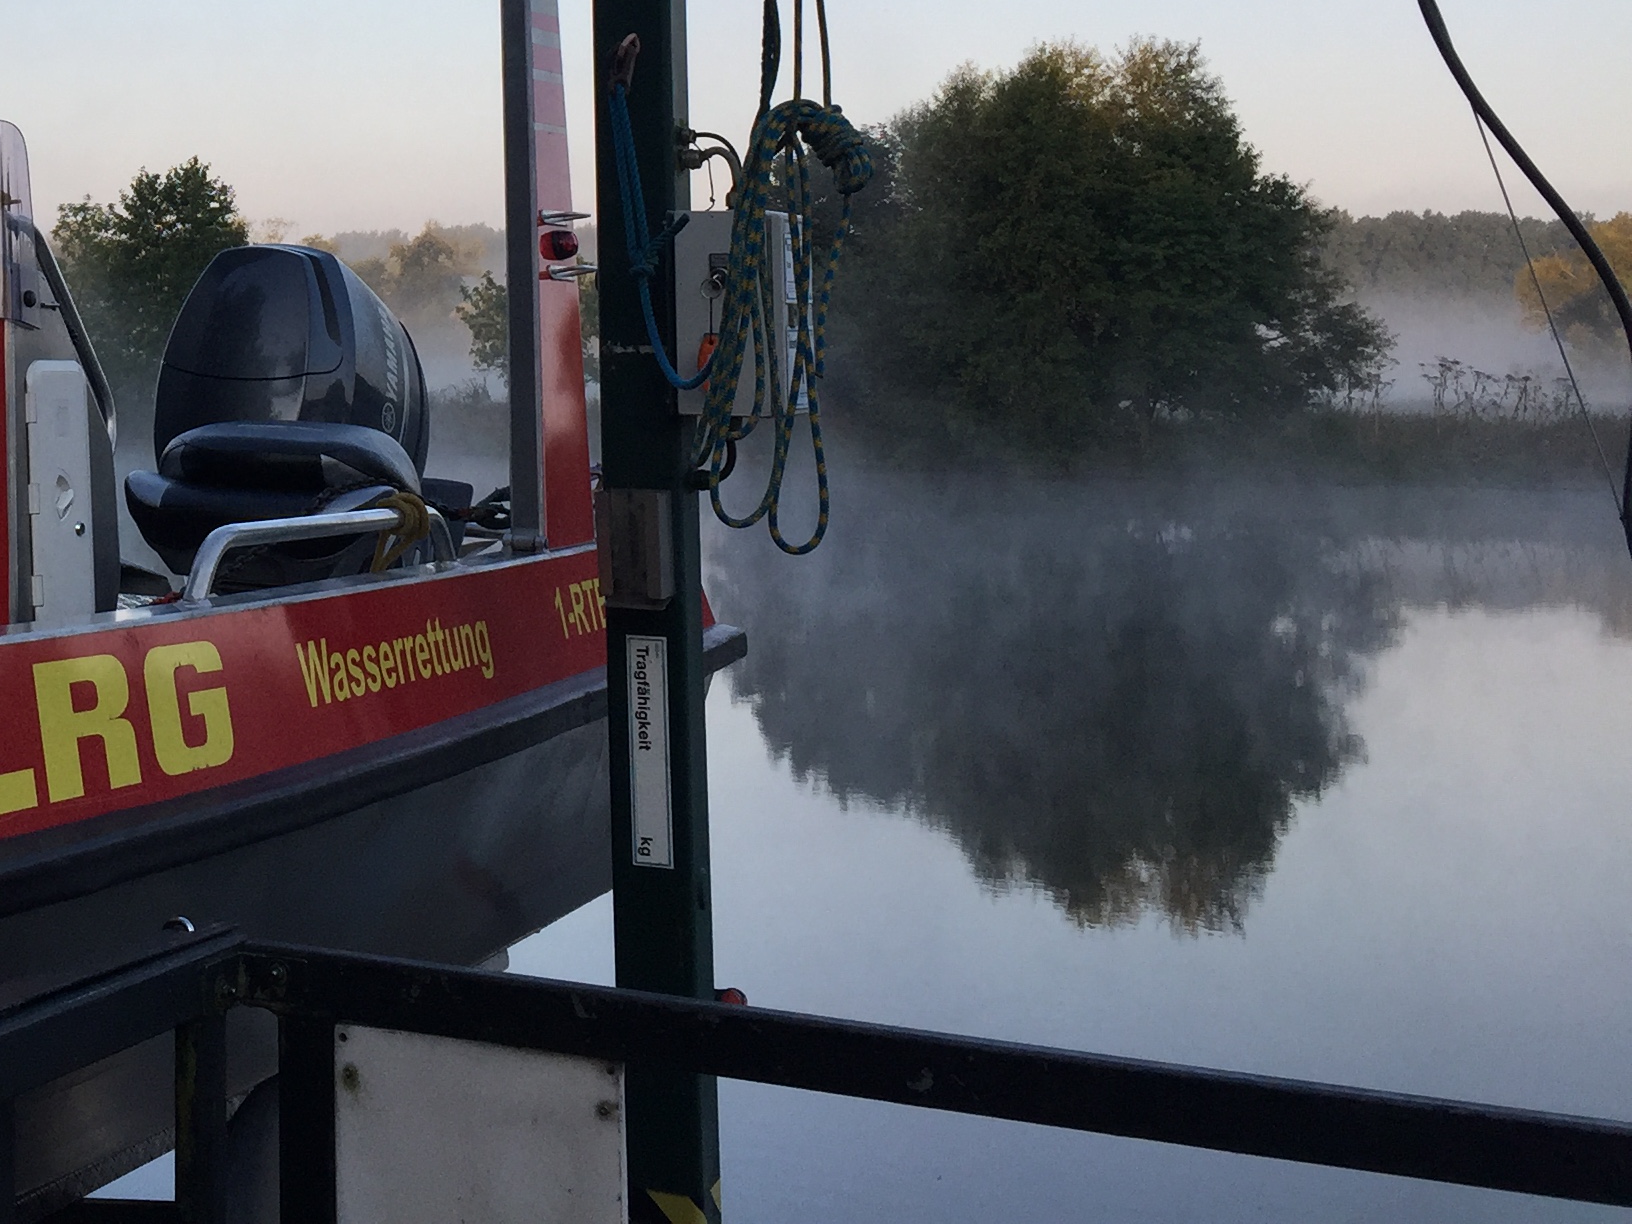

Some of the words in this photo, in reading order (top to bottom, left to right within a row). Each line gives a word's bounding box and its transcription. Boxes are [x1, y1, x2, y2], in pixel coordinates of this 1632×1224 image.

[295, 615, 495, 708] Wasserrettung
[633, 645, 653, 752] Tragfähigkeit
[637, 835, 654, 857] kg
